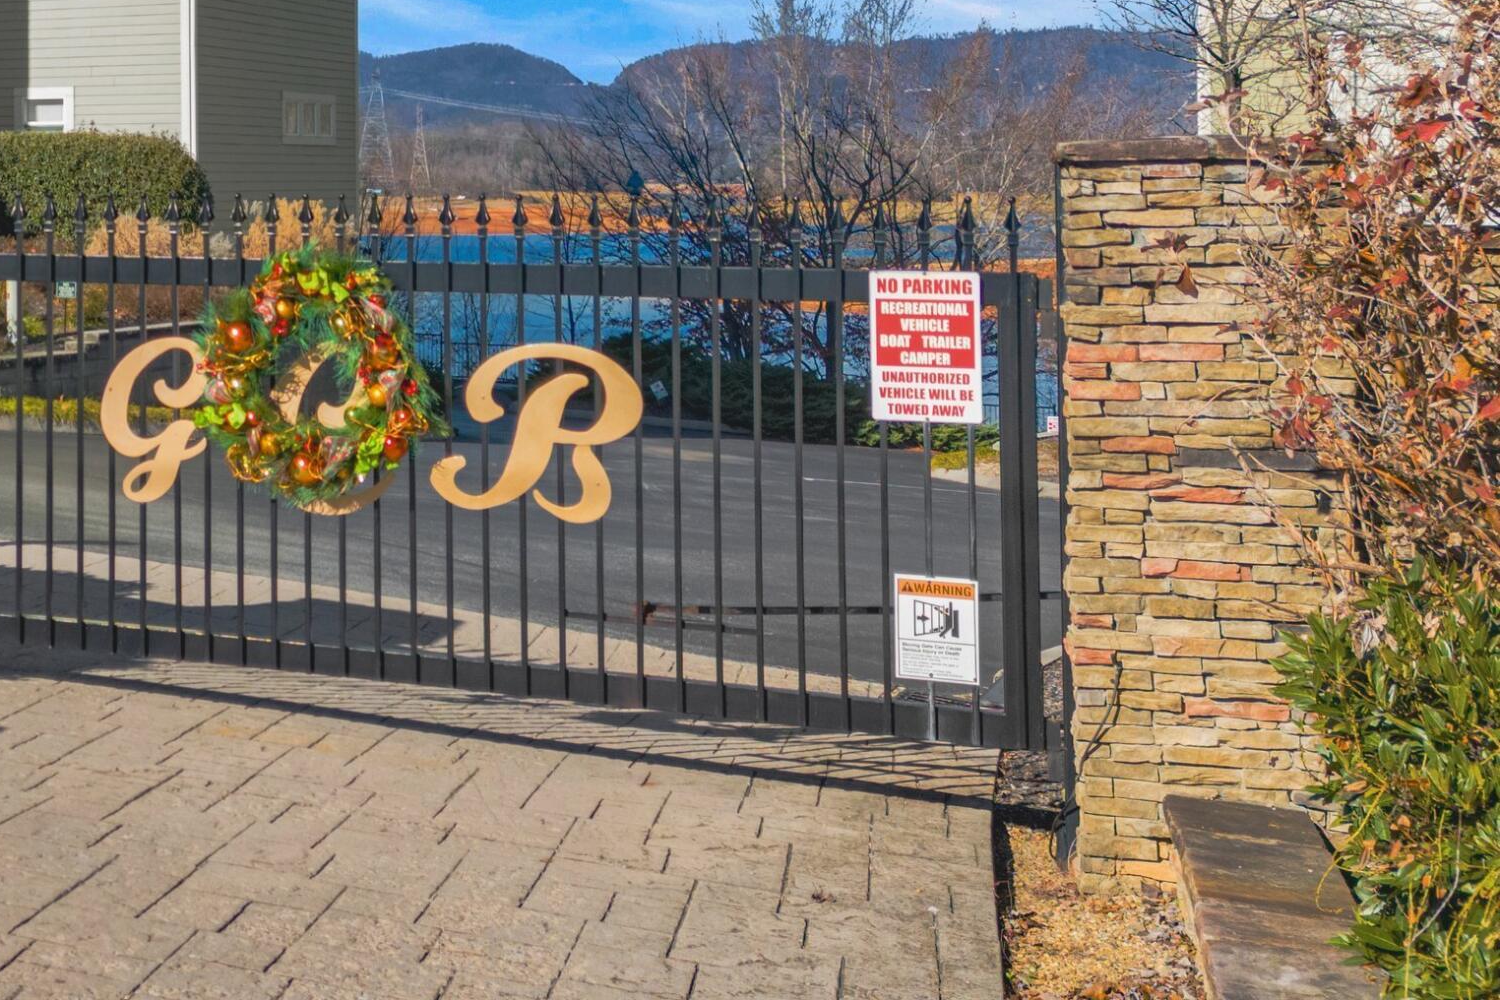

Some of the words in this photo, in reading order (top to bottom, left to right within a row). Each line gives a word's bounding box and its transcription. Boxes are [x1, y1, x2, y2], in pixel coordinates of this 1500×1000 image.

[876, 277, 898, 293] NO
[902, 278, 973, 295] PARKING
[880, 301, 969, 316] RECREATIONAL
[900, 318, 950, 332] VEHICLE
[880, 334, 911, 348] BOAT
[921, 335, 971, 350] TRAILER
[900, 352, 951, 366] CAMPER
[882, 370, 971, 385] UNAUTHORIZED
[879, 387, 926, 400] VEHICLE
[928, 388, 956, 401] WILL
[959, 389, 975, 402] BE
[887, 402, 929, 416] TOWED
[931, 404, 966, 417] AWAY
[914, 582, 972, 597] WARNING
